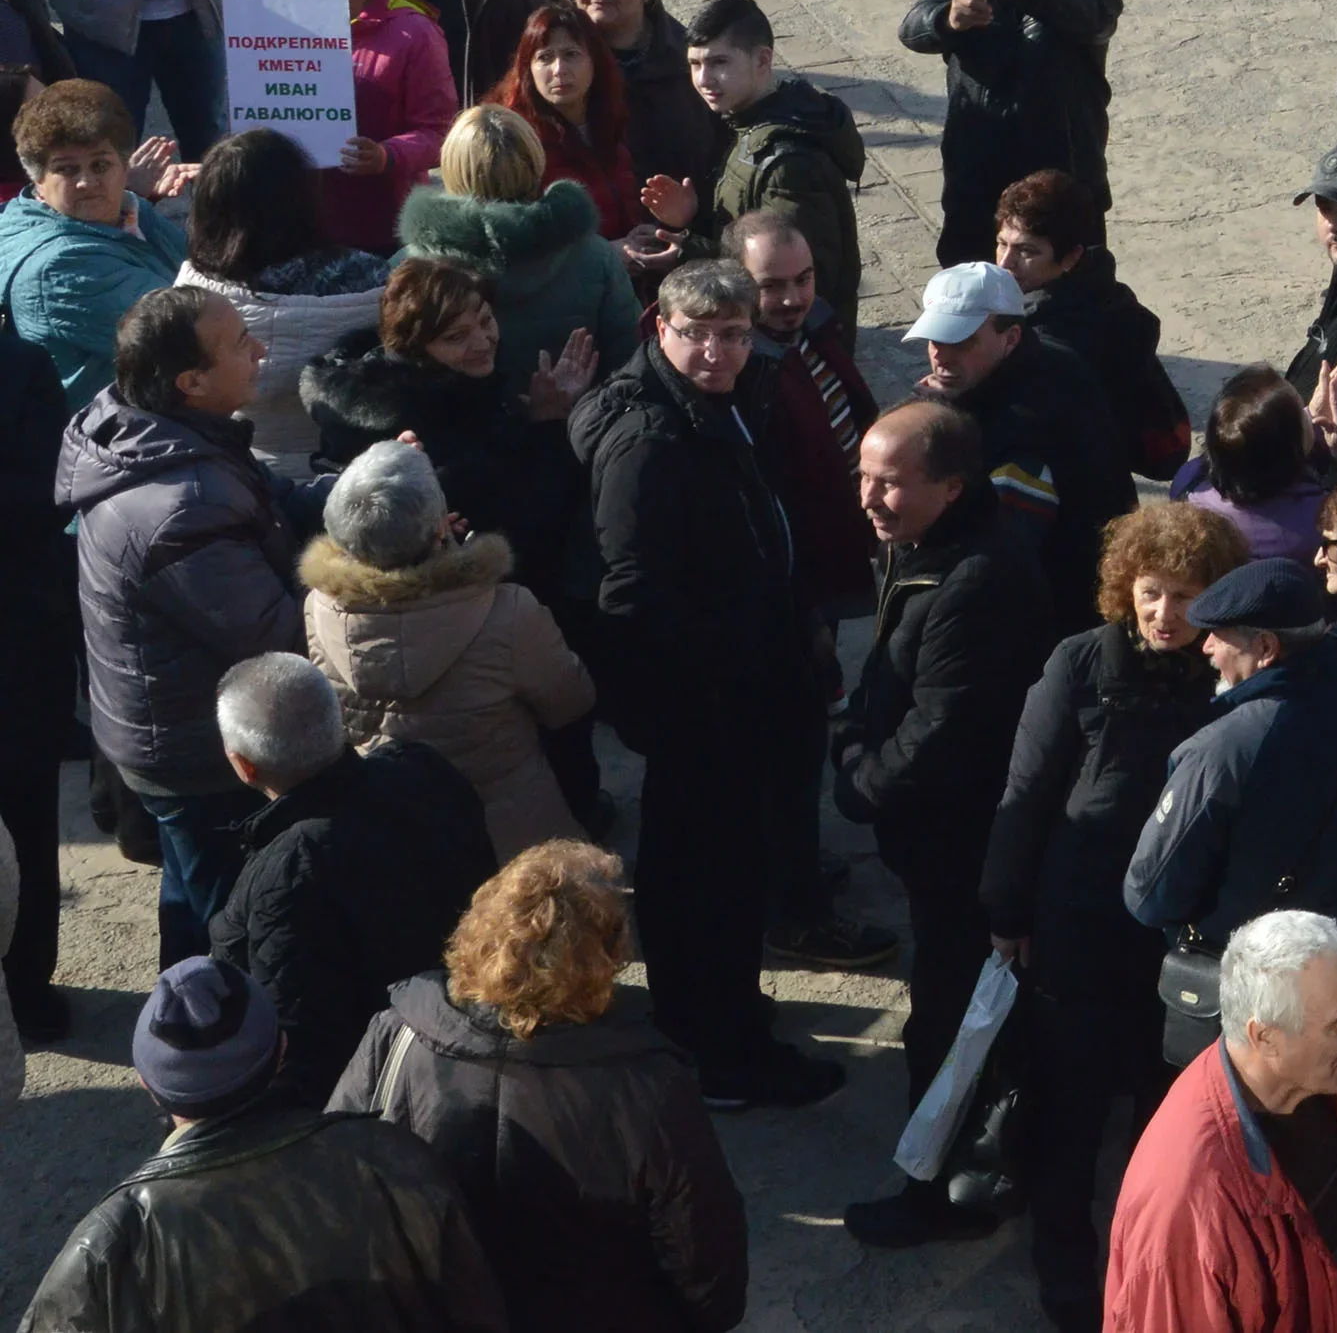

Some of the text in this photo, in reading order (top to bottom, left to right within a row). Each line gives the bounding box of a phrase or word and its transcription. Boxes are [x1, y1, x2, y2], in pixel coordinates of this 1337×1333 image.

[228, 36, 349, 51] ПОДКРЕПЯМЕ
[258, 59, 322, 72] КМЕТА!
[265, 83, 317, 96] ИВАН
[233, 107, 351, 121] ГАВАЛЮГОВ
